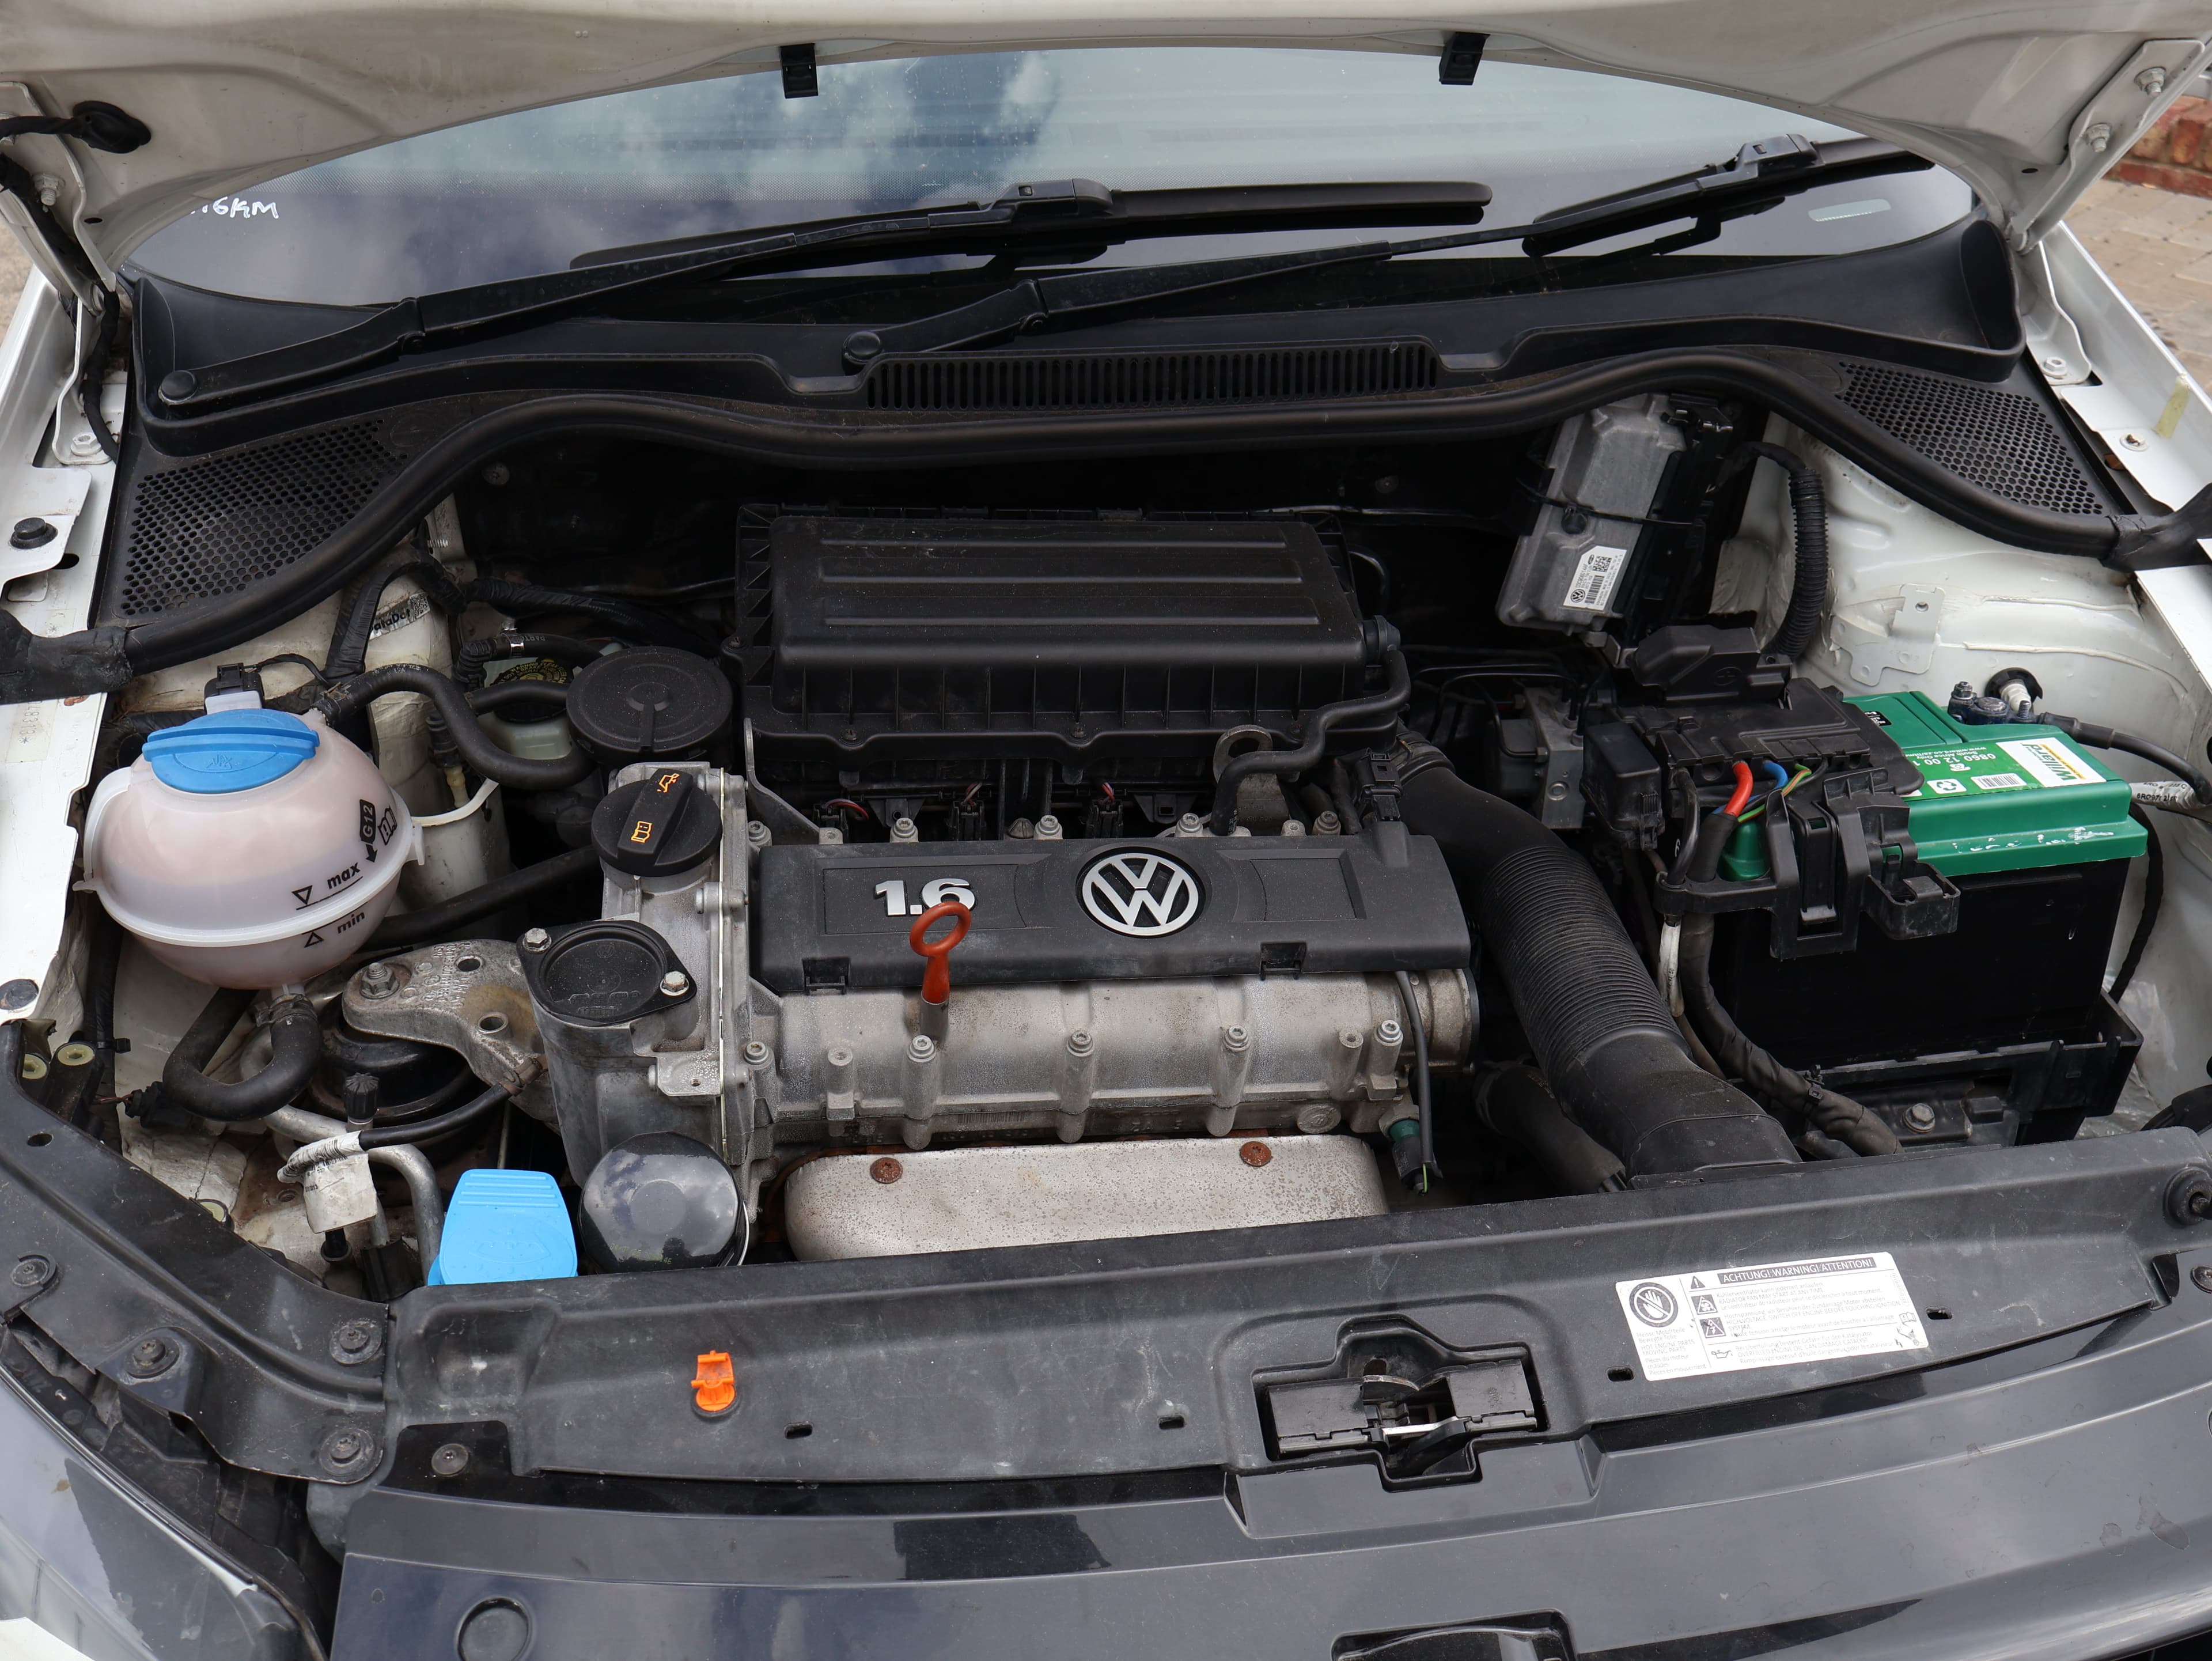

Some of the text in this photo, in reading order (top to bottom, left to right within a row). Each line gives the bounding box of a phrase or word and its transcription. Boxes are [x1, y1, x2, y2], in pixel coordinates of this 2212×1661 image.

[191, 196, 279, 219] 6KM
[372, 608, 411, 630] ataDot
[1964, 753, 1996, 762] 0860
[2022, 743, 2078, 781] Willard
[363, 804, 373, 837] G12
[327, 862, 361, 890] max
[874, 877, 976, 917] 1.6
[1082, 853, 1199, 936] VW
[337, 911, 365, 934] min
[1722, 1259, 1872, 1282] ACHTUNG! WARNING! ATTENTION!
[1846, 1303, 1874, 1311] TOUCHING
[1737, 1349, 1770, 1357] OVERFILLED
